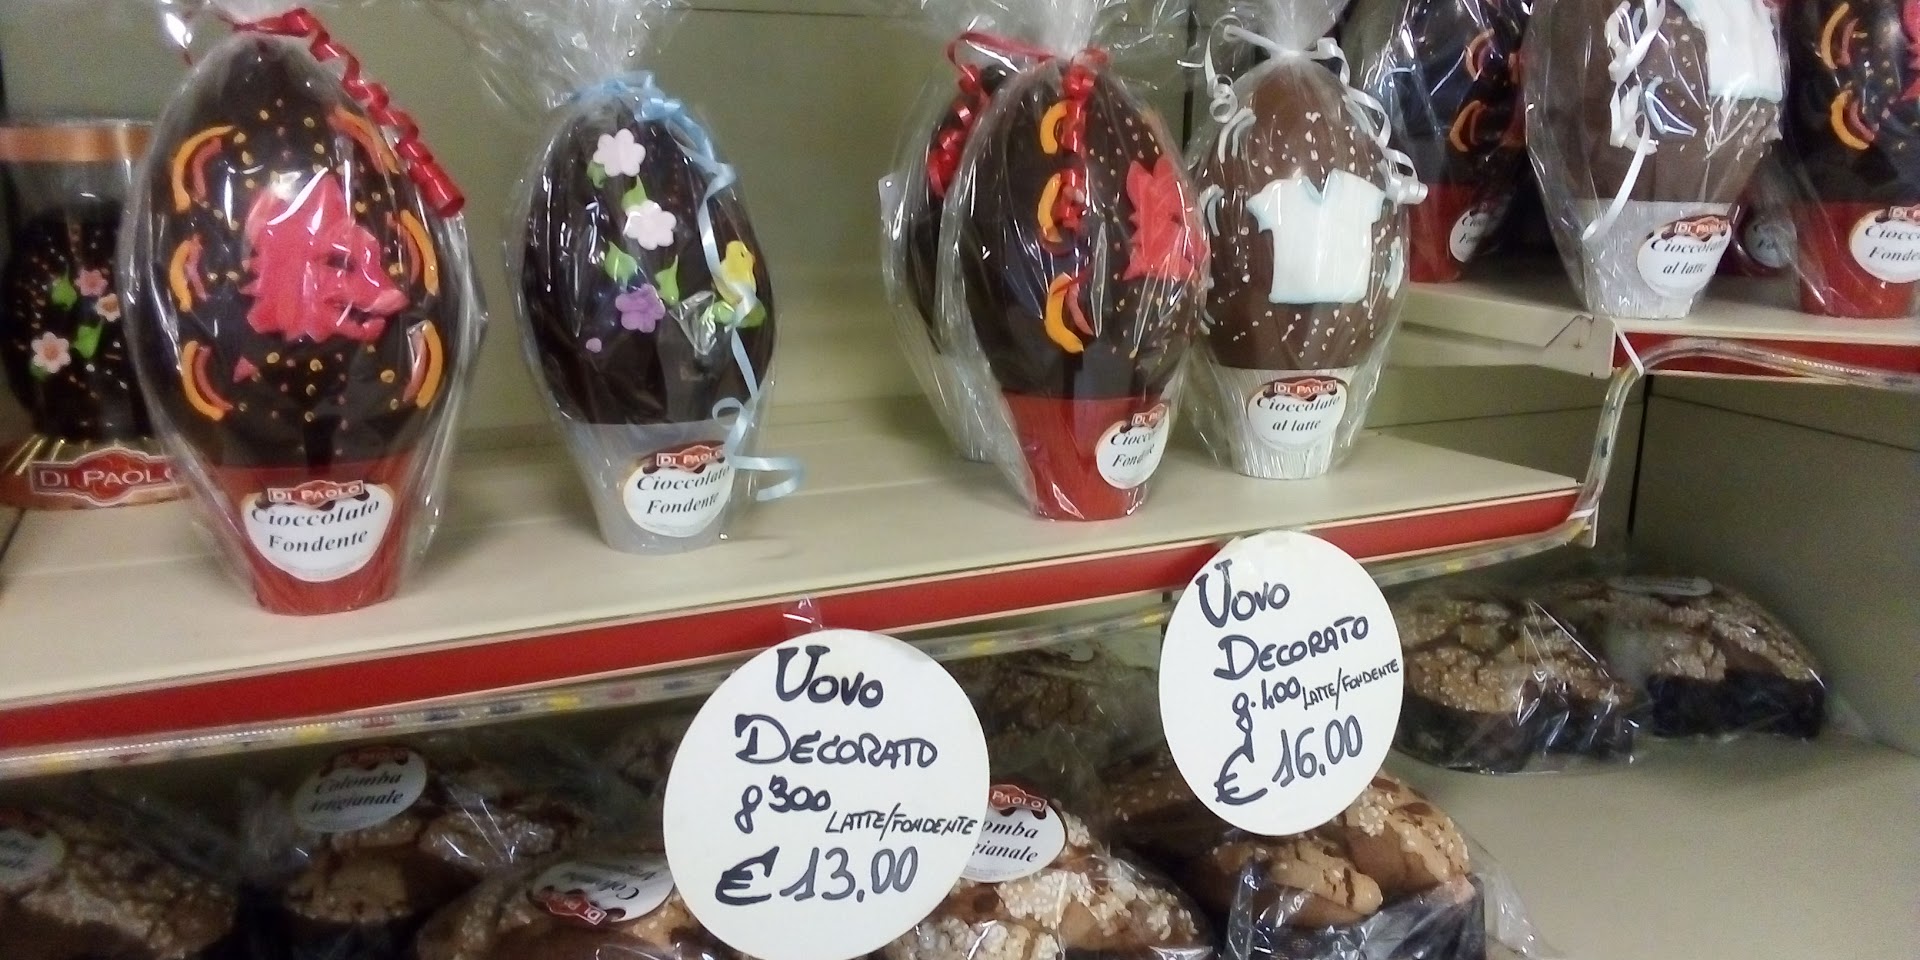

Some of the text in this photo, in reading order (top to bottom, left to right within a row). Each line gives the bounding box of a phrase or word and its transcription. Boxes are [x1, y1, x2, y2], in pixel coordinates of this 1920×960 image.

[1662, 261, 1706, 275] al latte
[1278, 382, 1334, 395] DI PAOLO
[1272, 419, 1322, 432] al latte
[660, 454, 677, 465] DI
[40, 471, 70, 487] DI
[636, 465, 731, 491] Cioccolato
[273, 484, 362, 502] DI PAOLO
[646, 491, 720, 515] Fondente
[251, 500, 380, 529] Cioccolato
[268, 528, 369, 554] Fondente
[991, 789, 1043, 809] PAOLO
